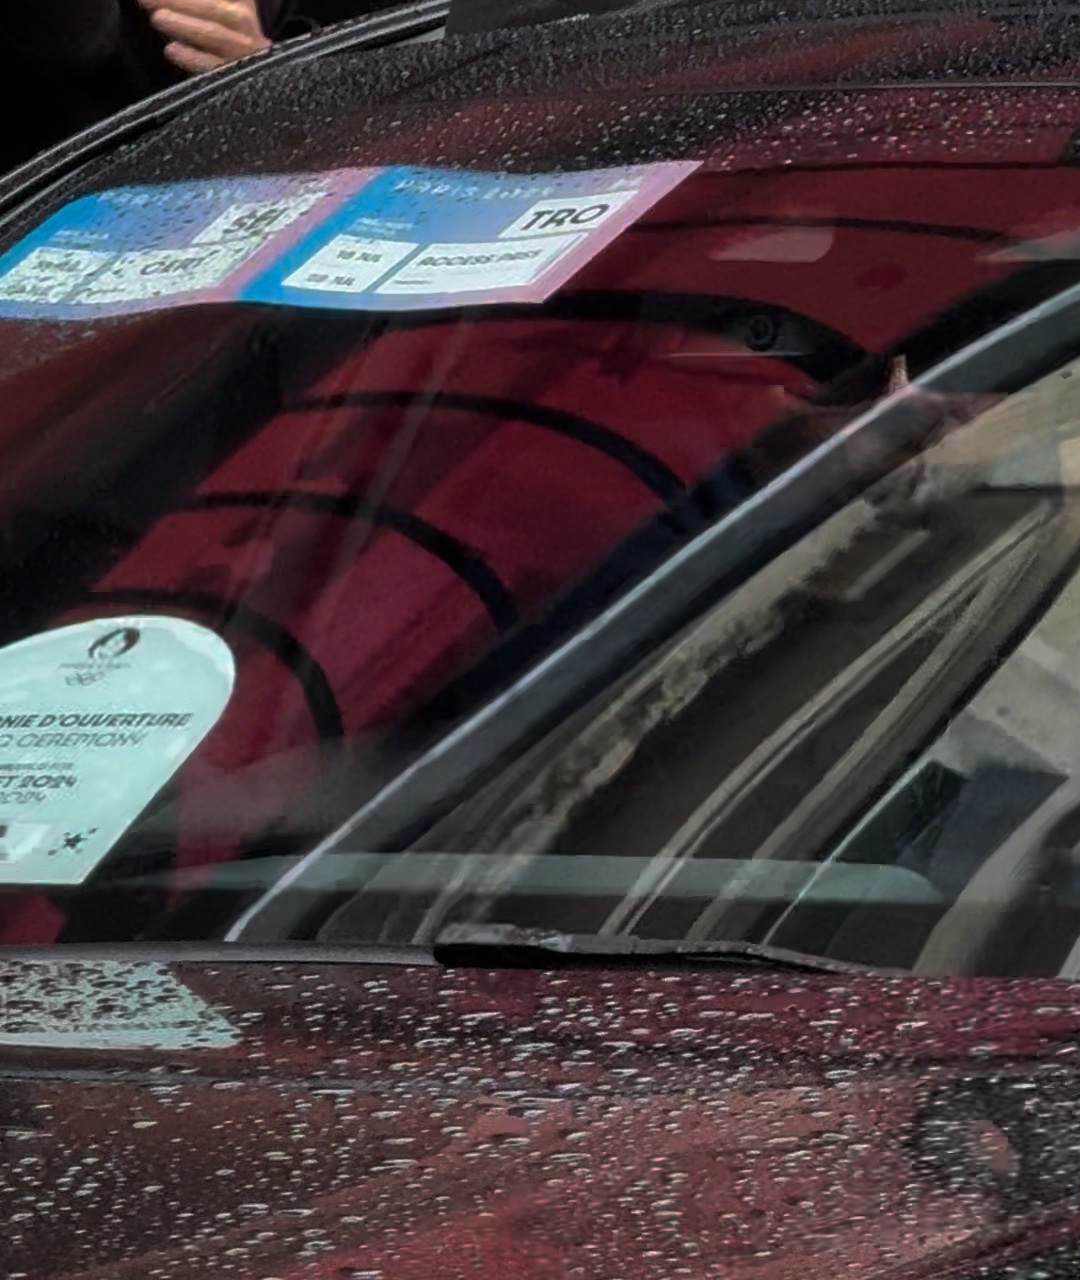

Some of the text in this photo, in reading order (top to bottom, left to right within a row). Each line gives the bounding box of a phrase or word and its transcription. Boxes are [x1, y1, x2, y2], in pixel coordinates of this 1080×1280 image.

[520, 203, 611, 231] TRO
[0, 713, 38, 729] NIE
[16, 731, 149, 748] CEREMONY
